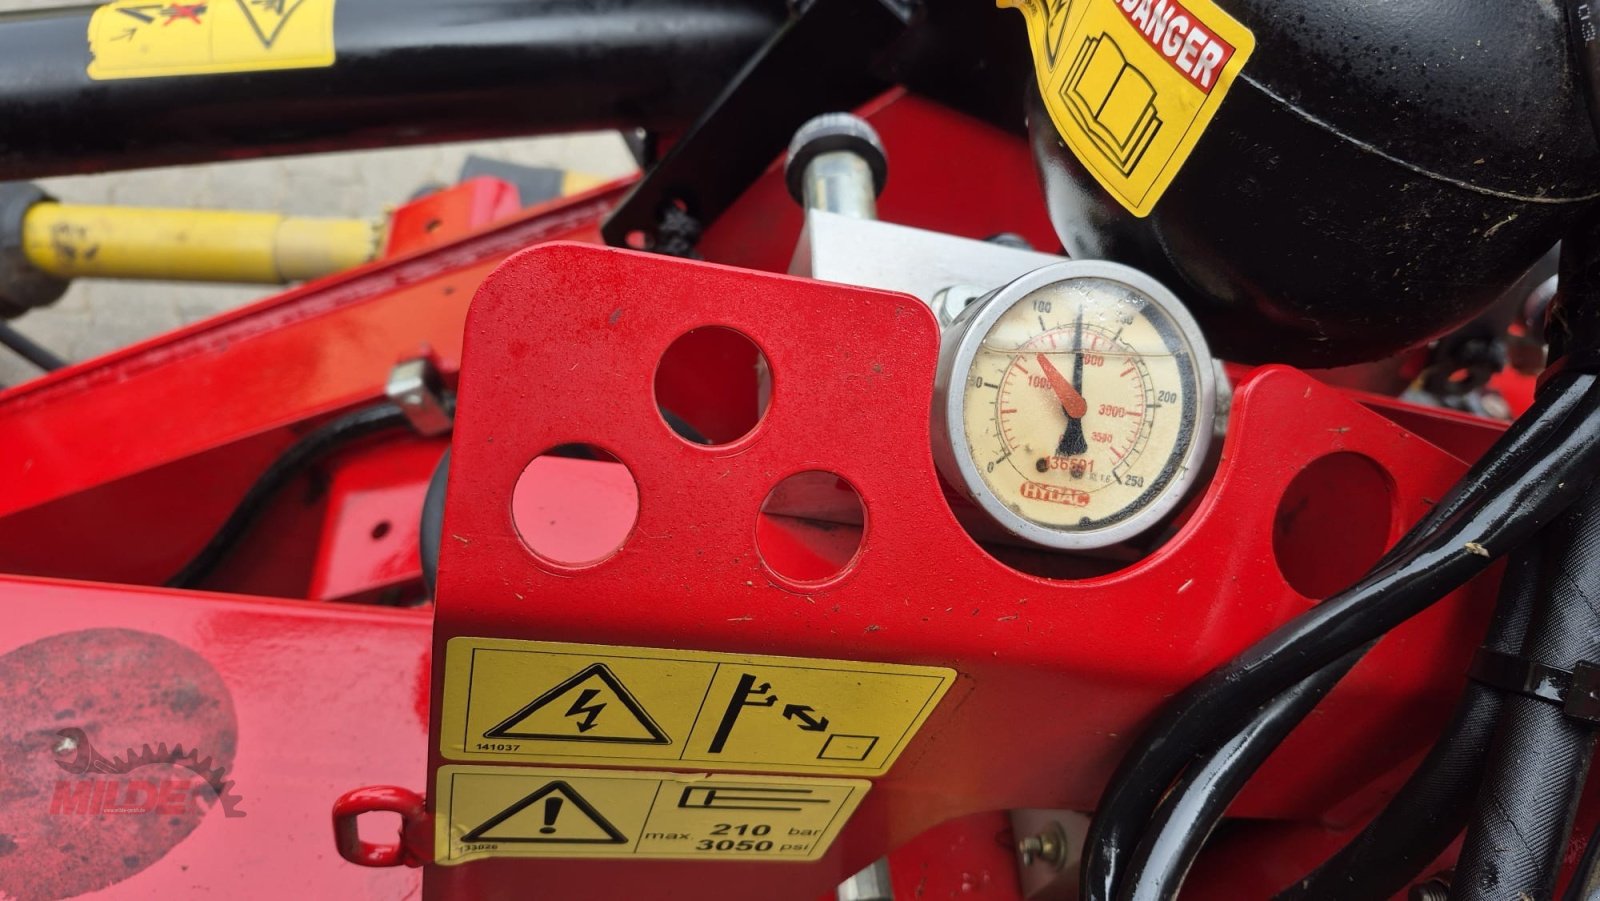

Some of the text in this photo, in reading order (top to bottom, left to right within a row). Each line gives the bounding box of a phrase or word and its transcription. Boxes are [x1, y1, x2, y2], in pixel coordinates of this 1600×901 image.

[1033, 300, 1052, 313] 100
[1157, 390, 1177, 404] 200
[1098, 404, 1125, 418] 3000
[987, 462, 995, 473] 0
[1125, 474, 1144, 488] 250
[1022, 482, 1089, 506] HYDAC
[477, 743, 521, 752] 141037
[644, 831, 694, 841] max.
[709, 823, 822, 837] 210 bar
[696, 839, 810, 852] 3050 psi
